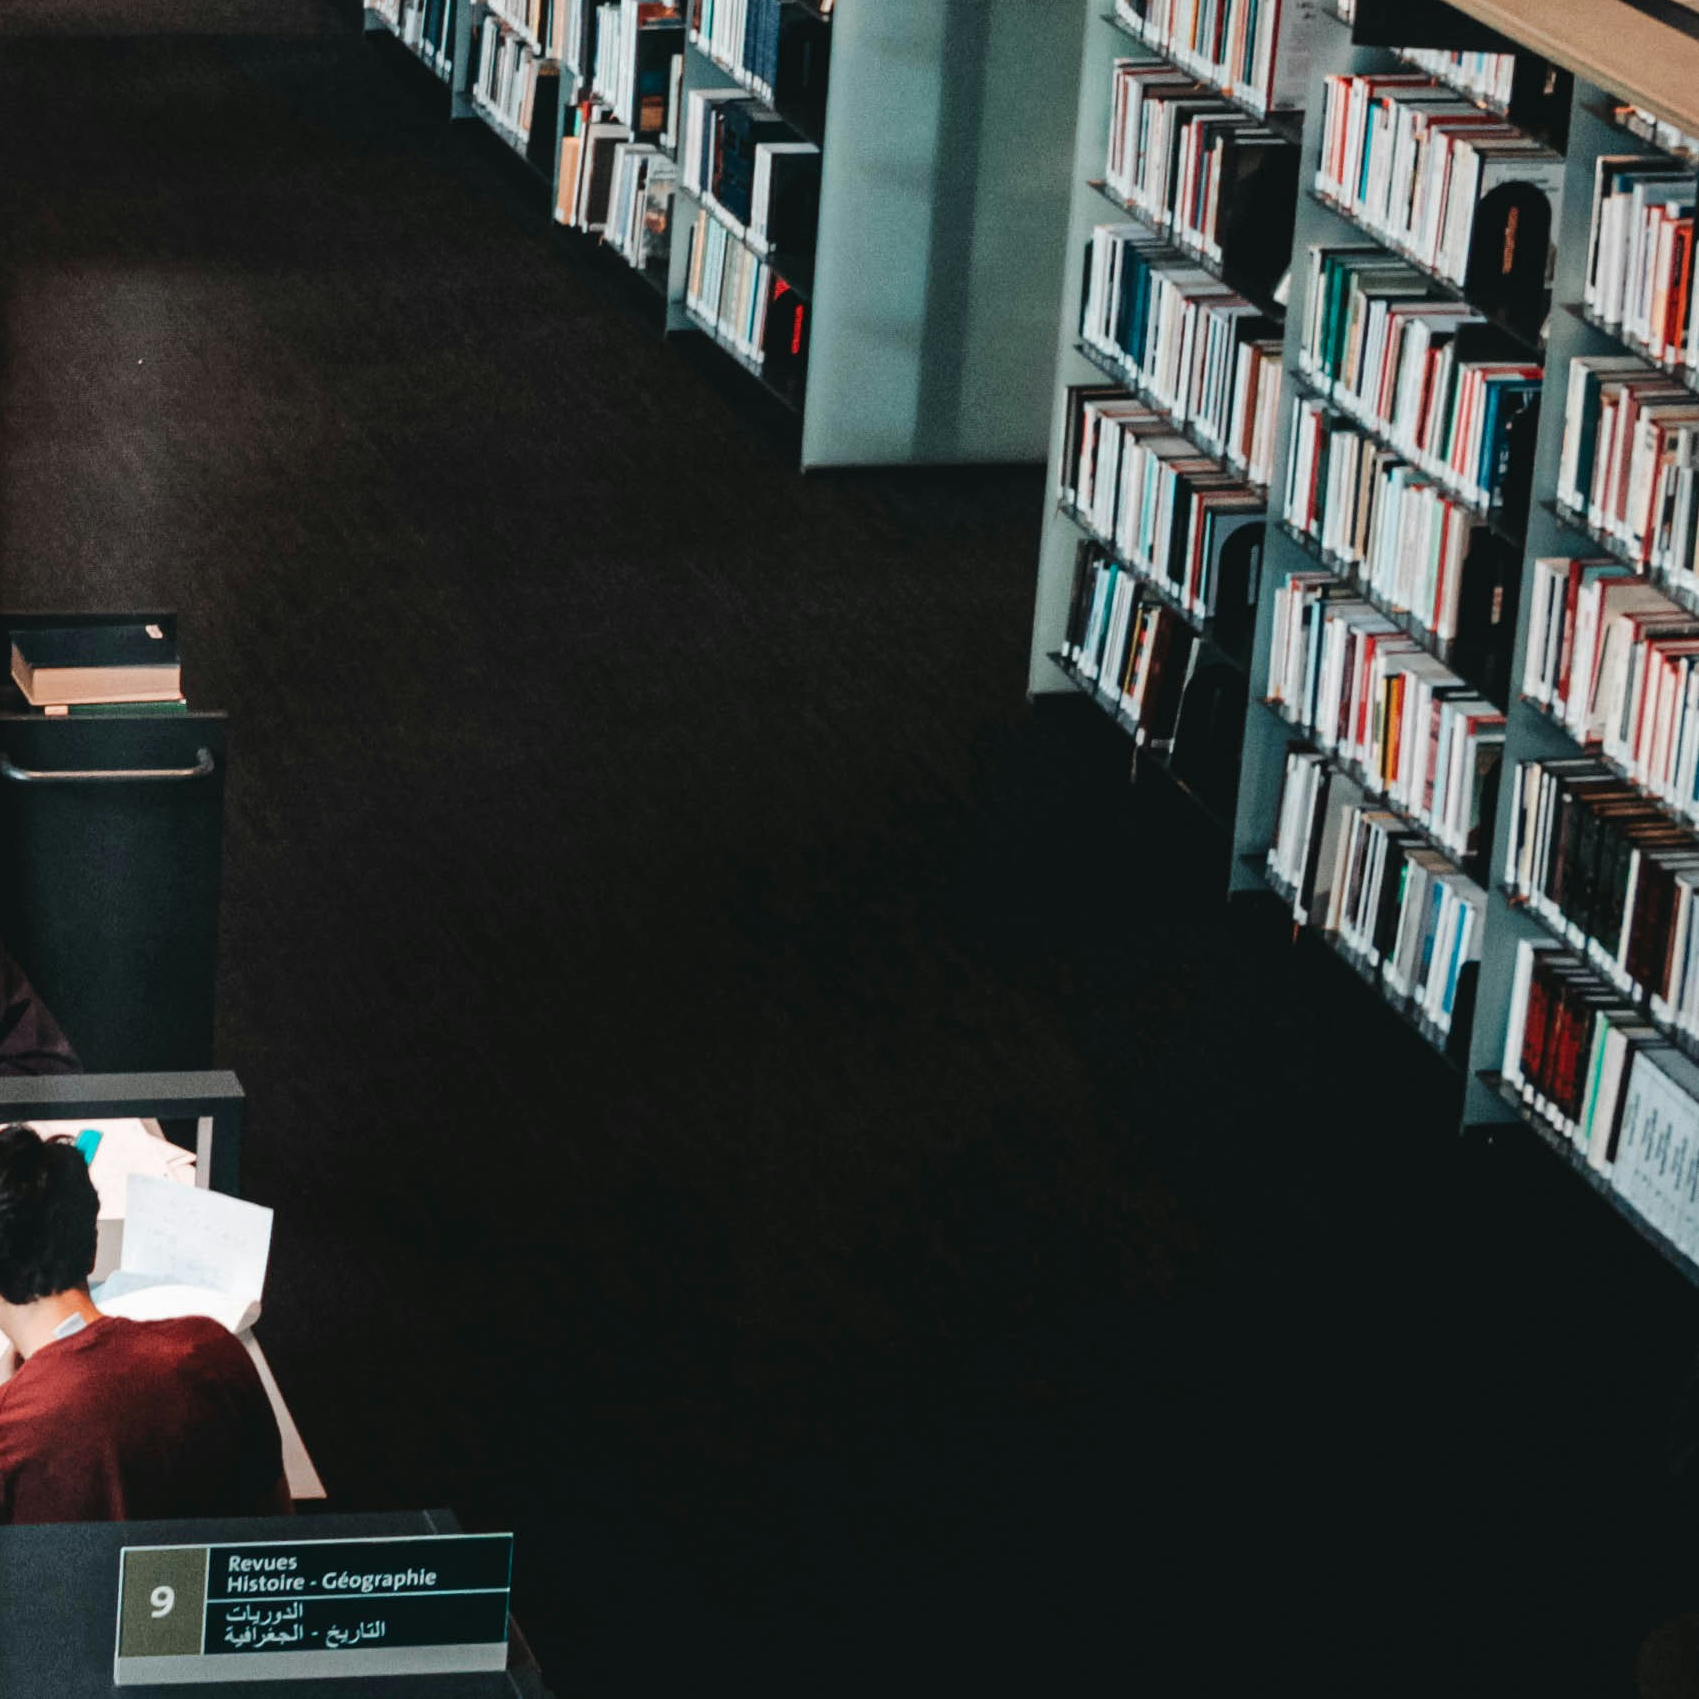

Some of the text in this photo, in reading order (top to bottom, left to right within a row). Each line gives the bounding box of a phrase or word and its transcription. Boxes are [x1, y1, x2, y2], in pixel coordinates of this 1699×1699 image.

[228, 1554, 298, 1573] Revues
[227, 1574, 305, 1594] Histoire
[321, 1568, 438, 1595] Géographie
[149, 1585, 176, 1619] 9
[225, 1602, 304, 1624] الدوريات
[223, 1623, 304, 1650] الجغرافية
[325, 1620, 386, 1649] التاريخ
